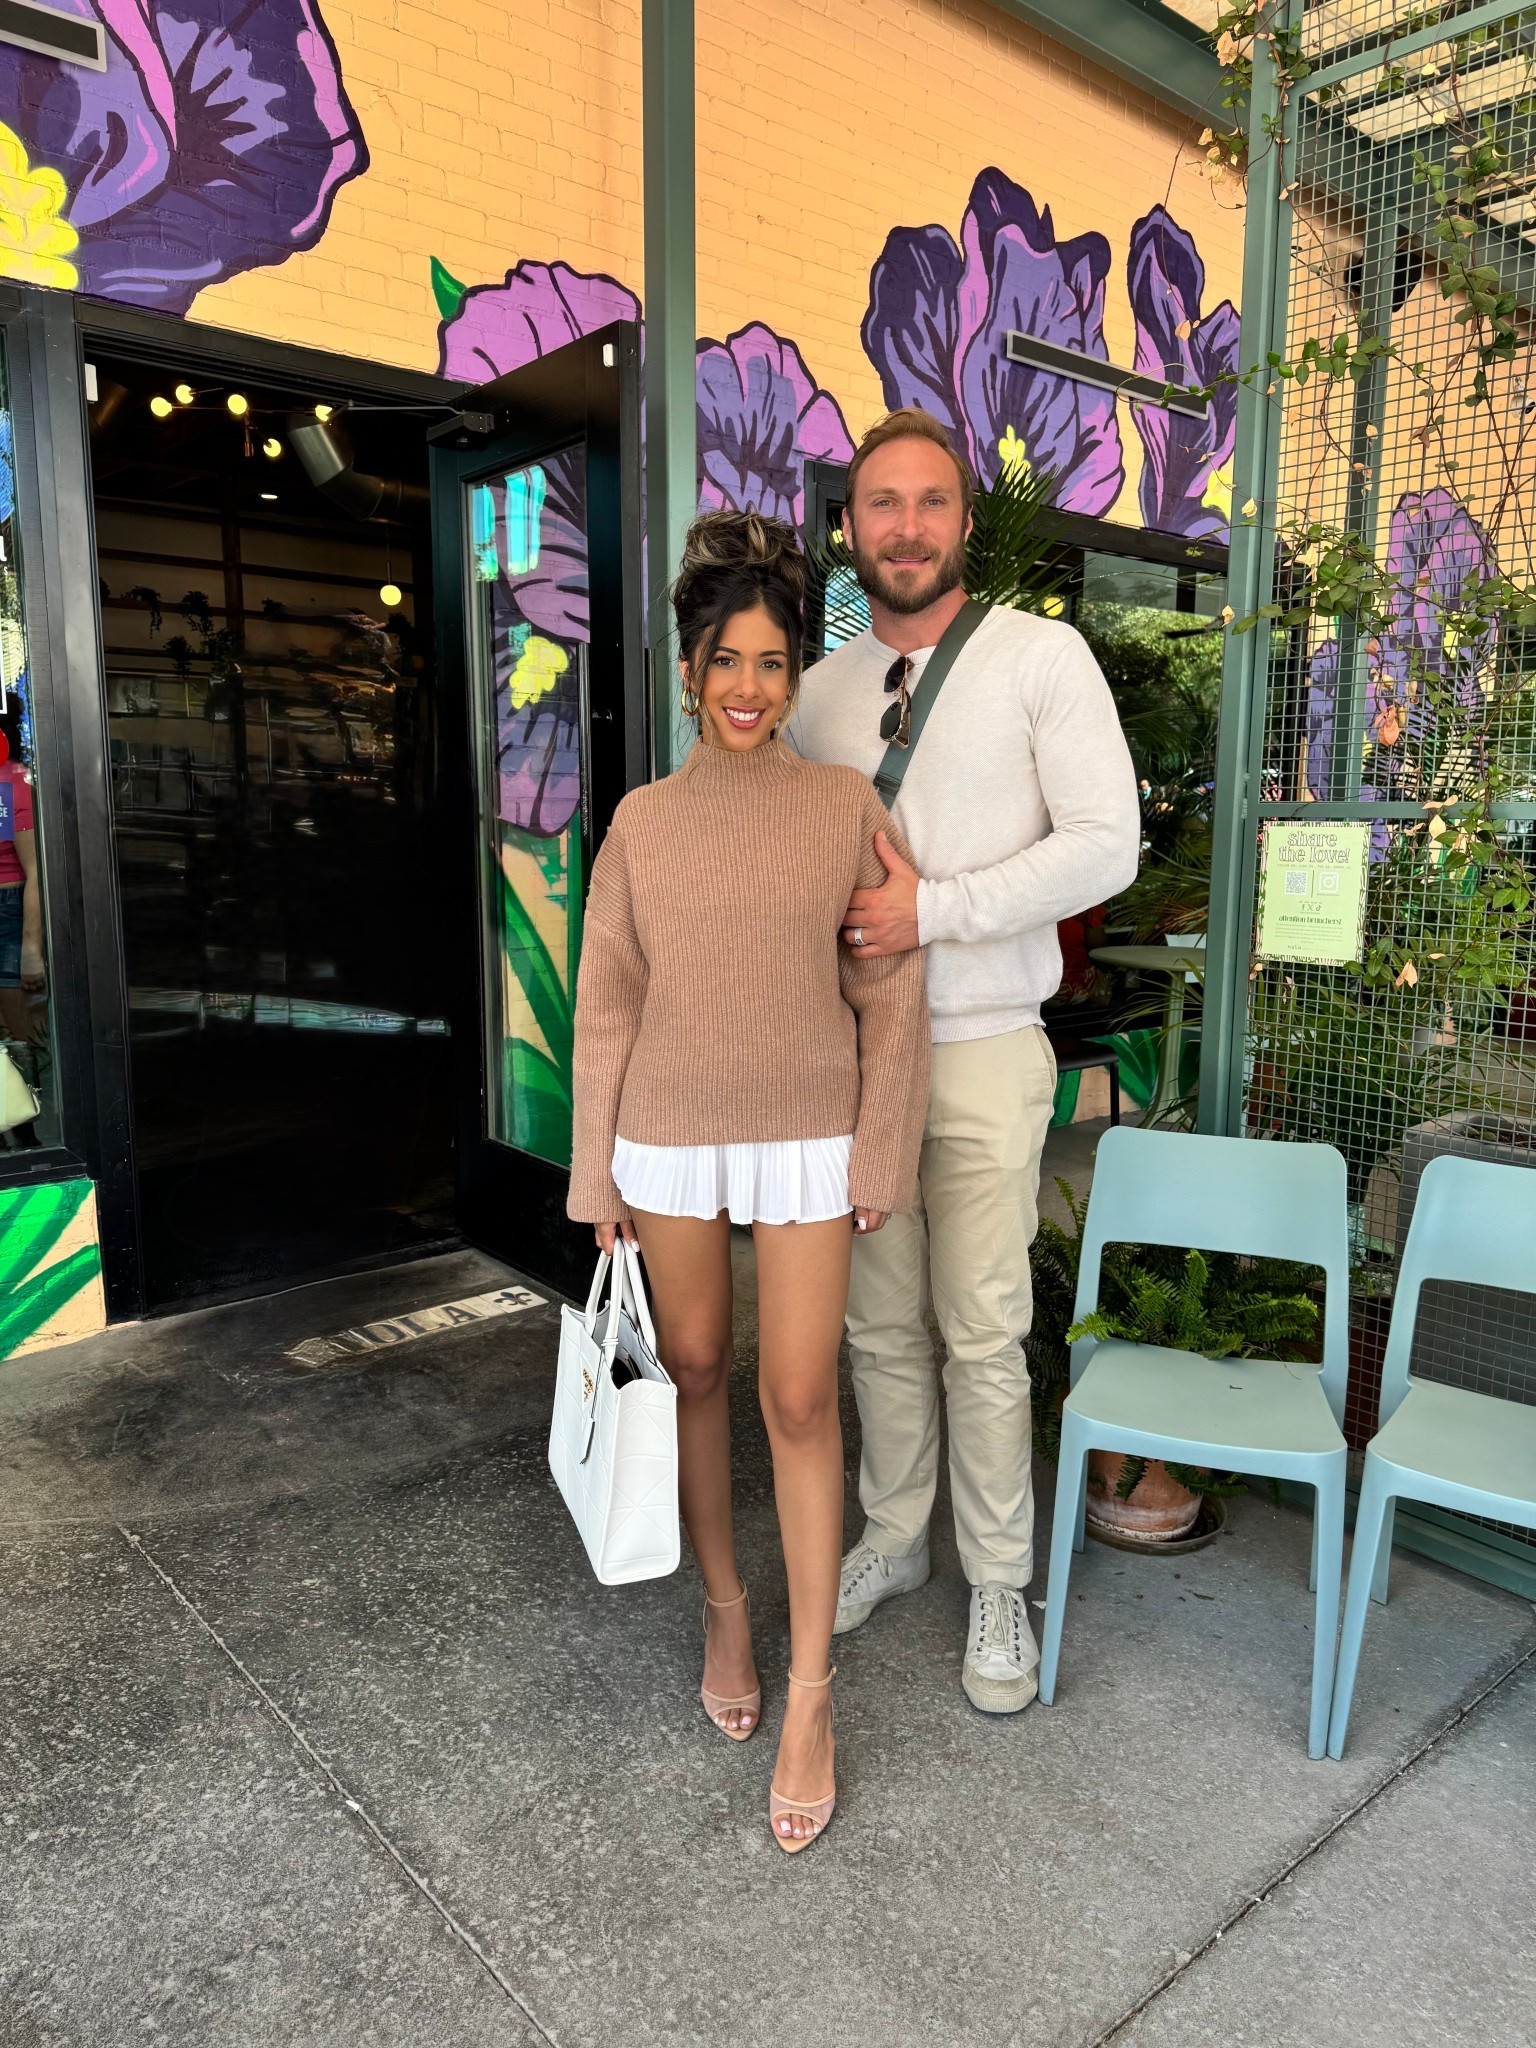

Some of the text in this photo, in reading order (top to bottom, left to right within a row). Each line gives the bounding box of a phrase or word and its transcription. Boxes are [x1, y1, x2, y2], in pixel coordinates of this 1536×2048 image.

[1287, 830, 1338, 847] share
[1278, 846, 1351, 864] the love!
[1278, 914, 1342, 925] attention brunchers!
